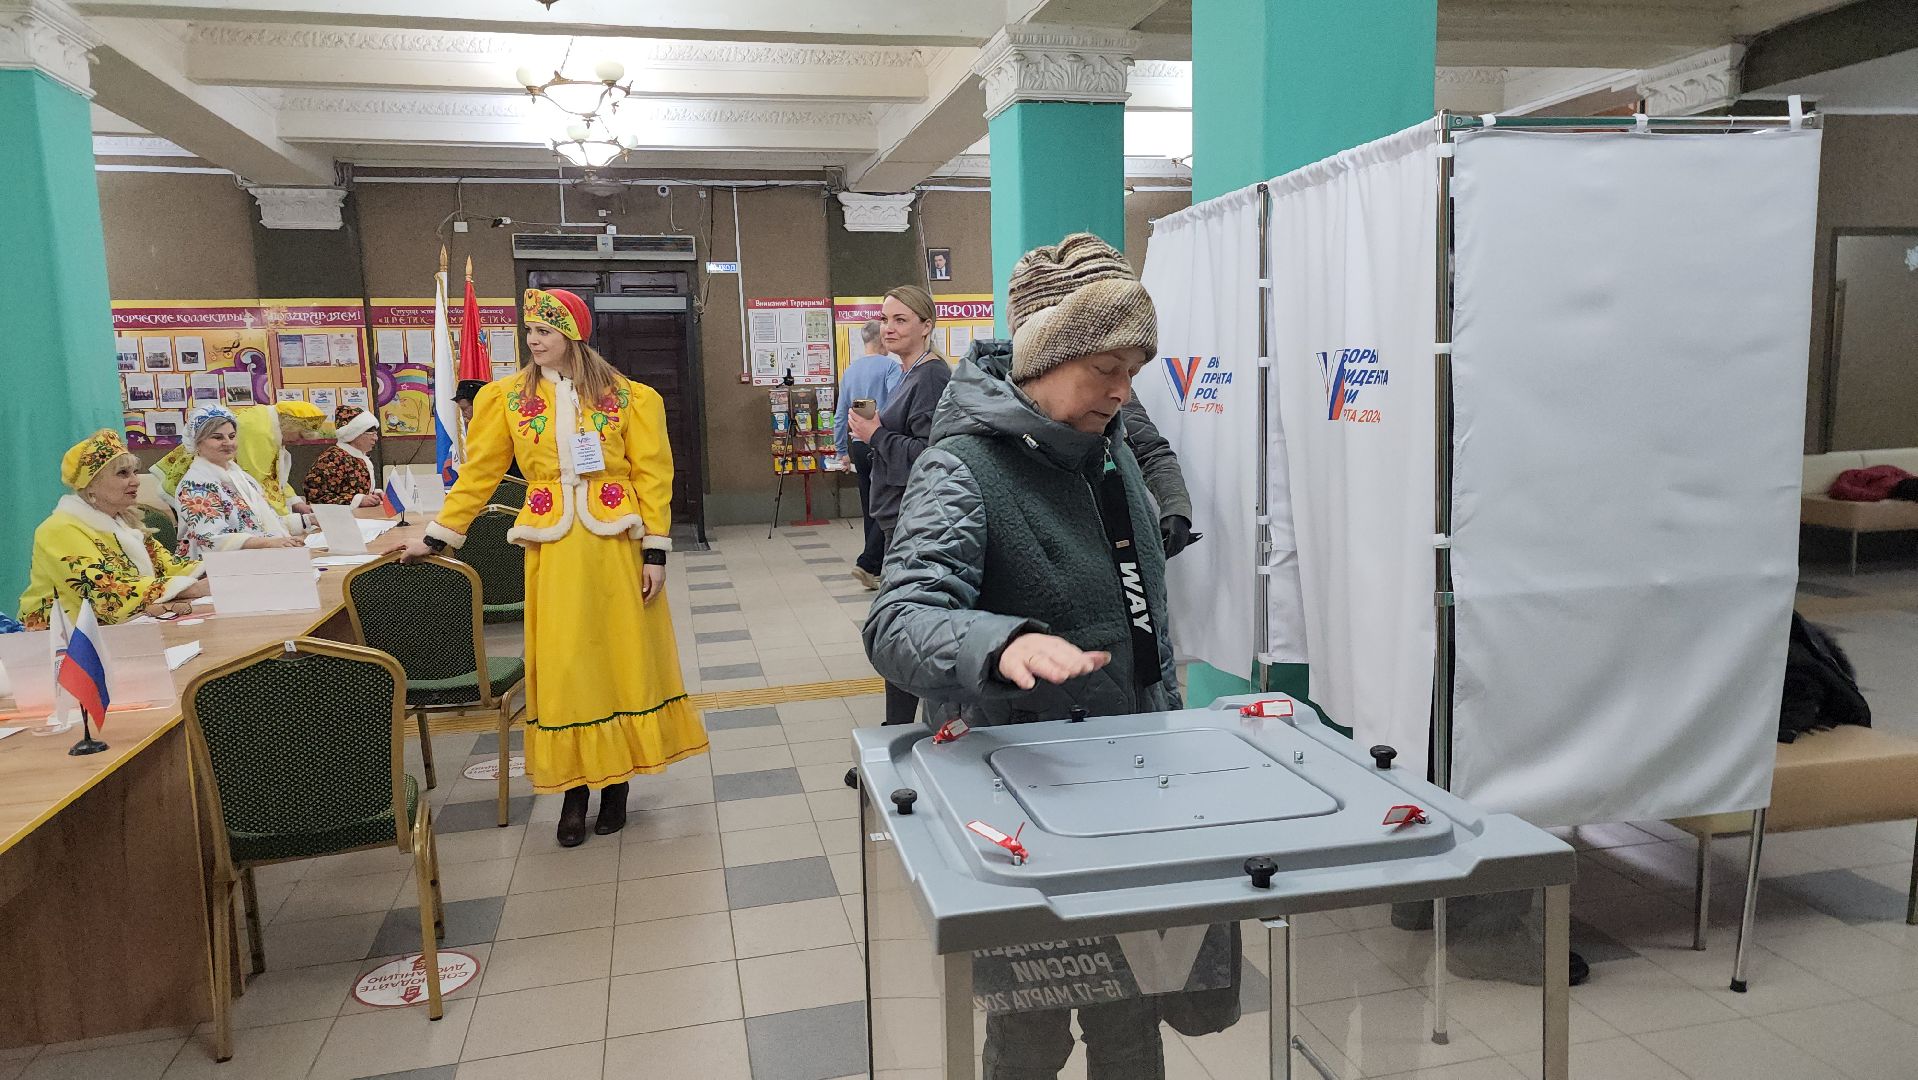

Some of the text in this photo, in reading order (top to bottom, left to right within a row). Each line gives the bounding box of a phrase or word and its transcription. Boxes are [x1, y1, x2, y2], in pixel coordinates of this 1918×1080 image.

[755, 299, 825, 308] Внимание! Терроризм!
[176, 313, 244, 324] КОЛЛЕКТИВЫ
[1343, 368, 1389, 387] ИДЕНТА
[1119, 561, 1153, 634] WAY
[359, 971, 469, 993] СОБЮДАЙТЕ
[367, 962, 466, 984] ДИСАНЦИЮ
